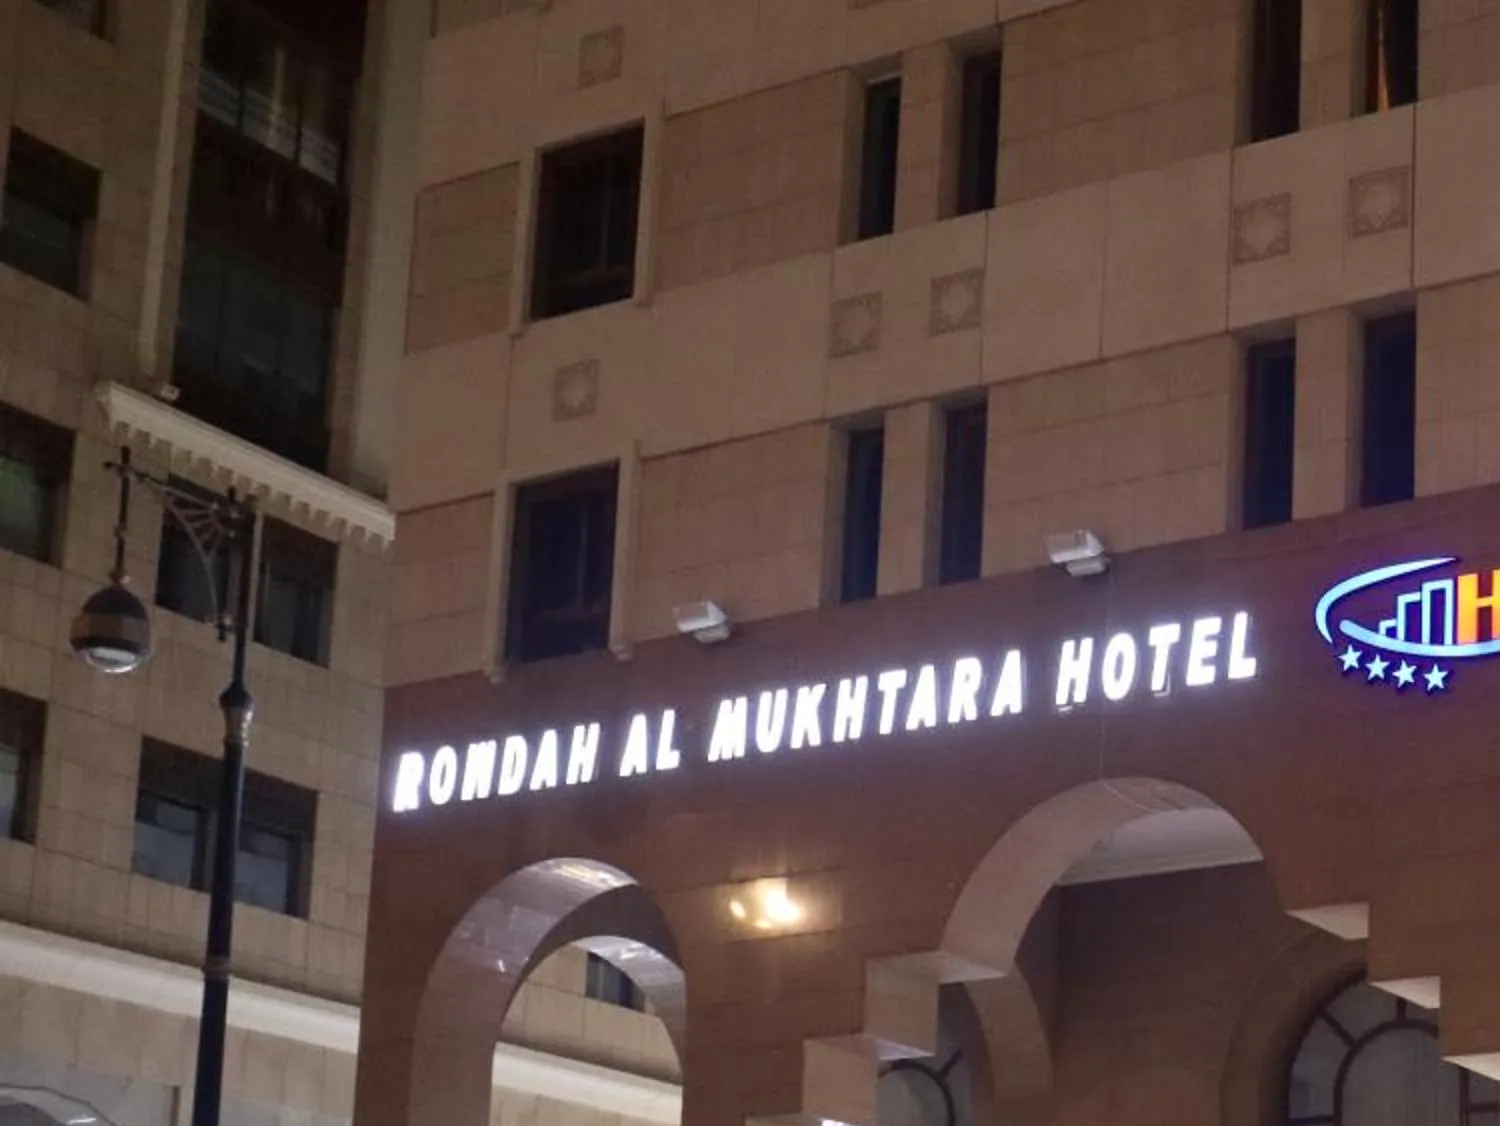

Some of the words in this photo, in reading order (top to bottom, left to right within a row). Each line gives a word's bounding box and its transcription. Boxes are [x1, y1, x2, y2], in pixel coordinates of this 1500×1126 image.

[618, 708, 681, 777] AL
[706, 649, 1024, 762] MUKHTARA
[1055, 610, 1257, 711] HOTEL
